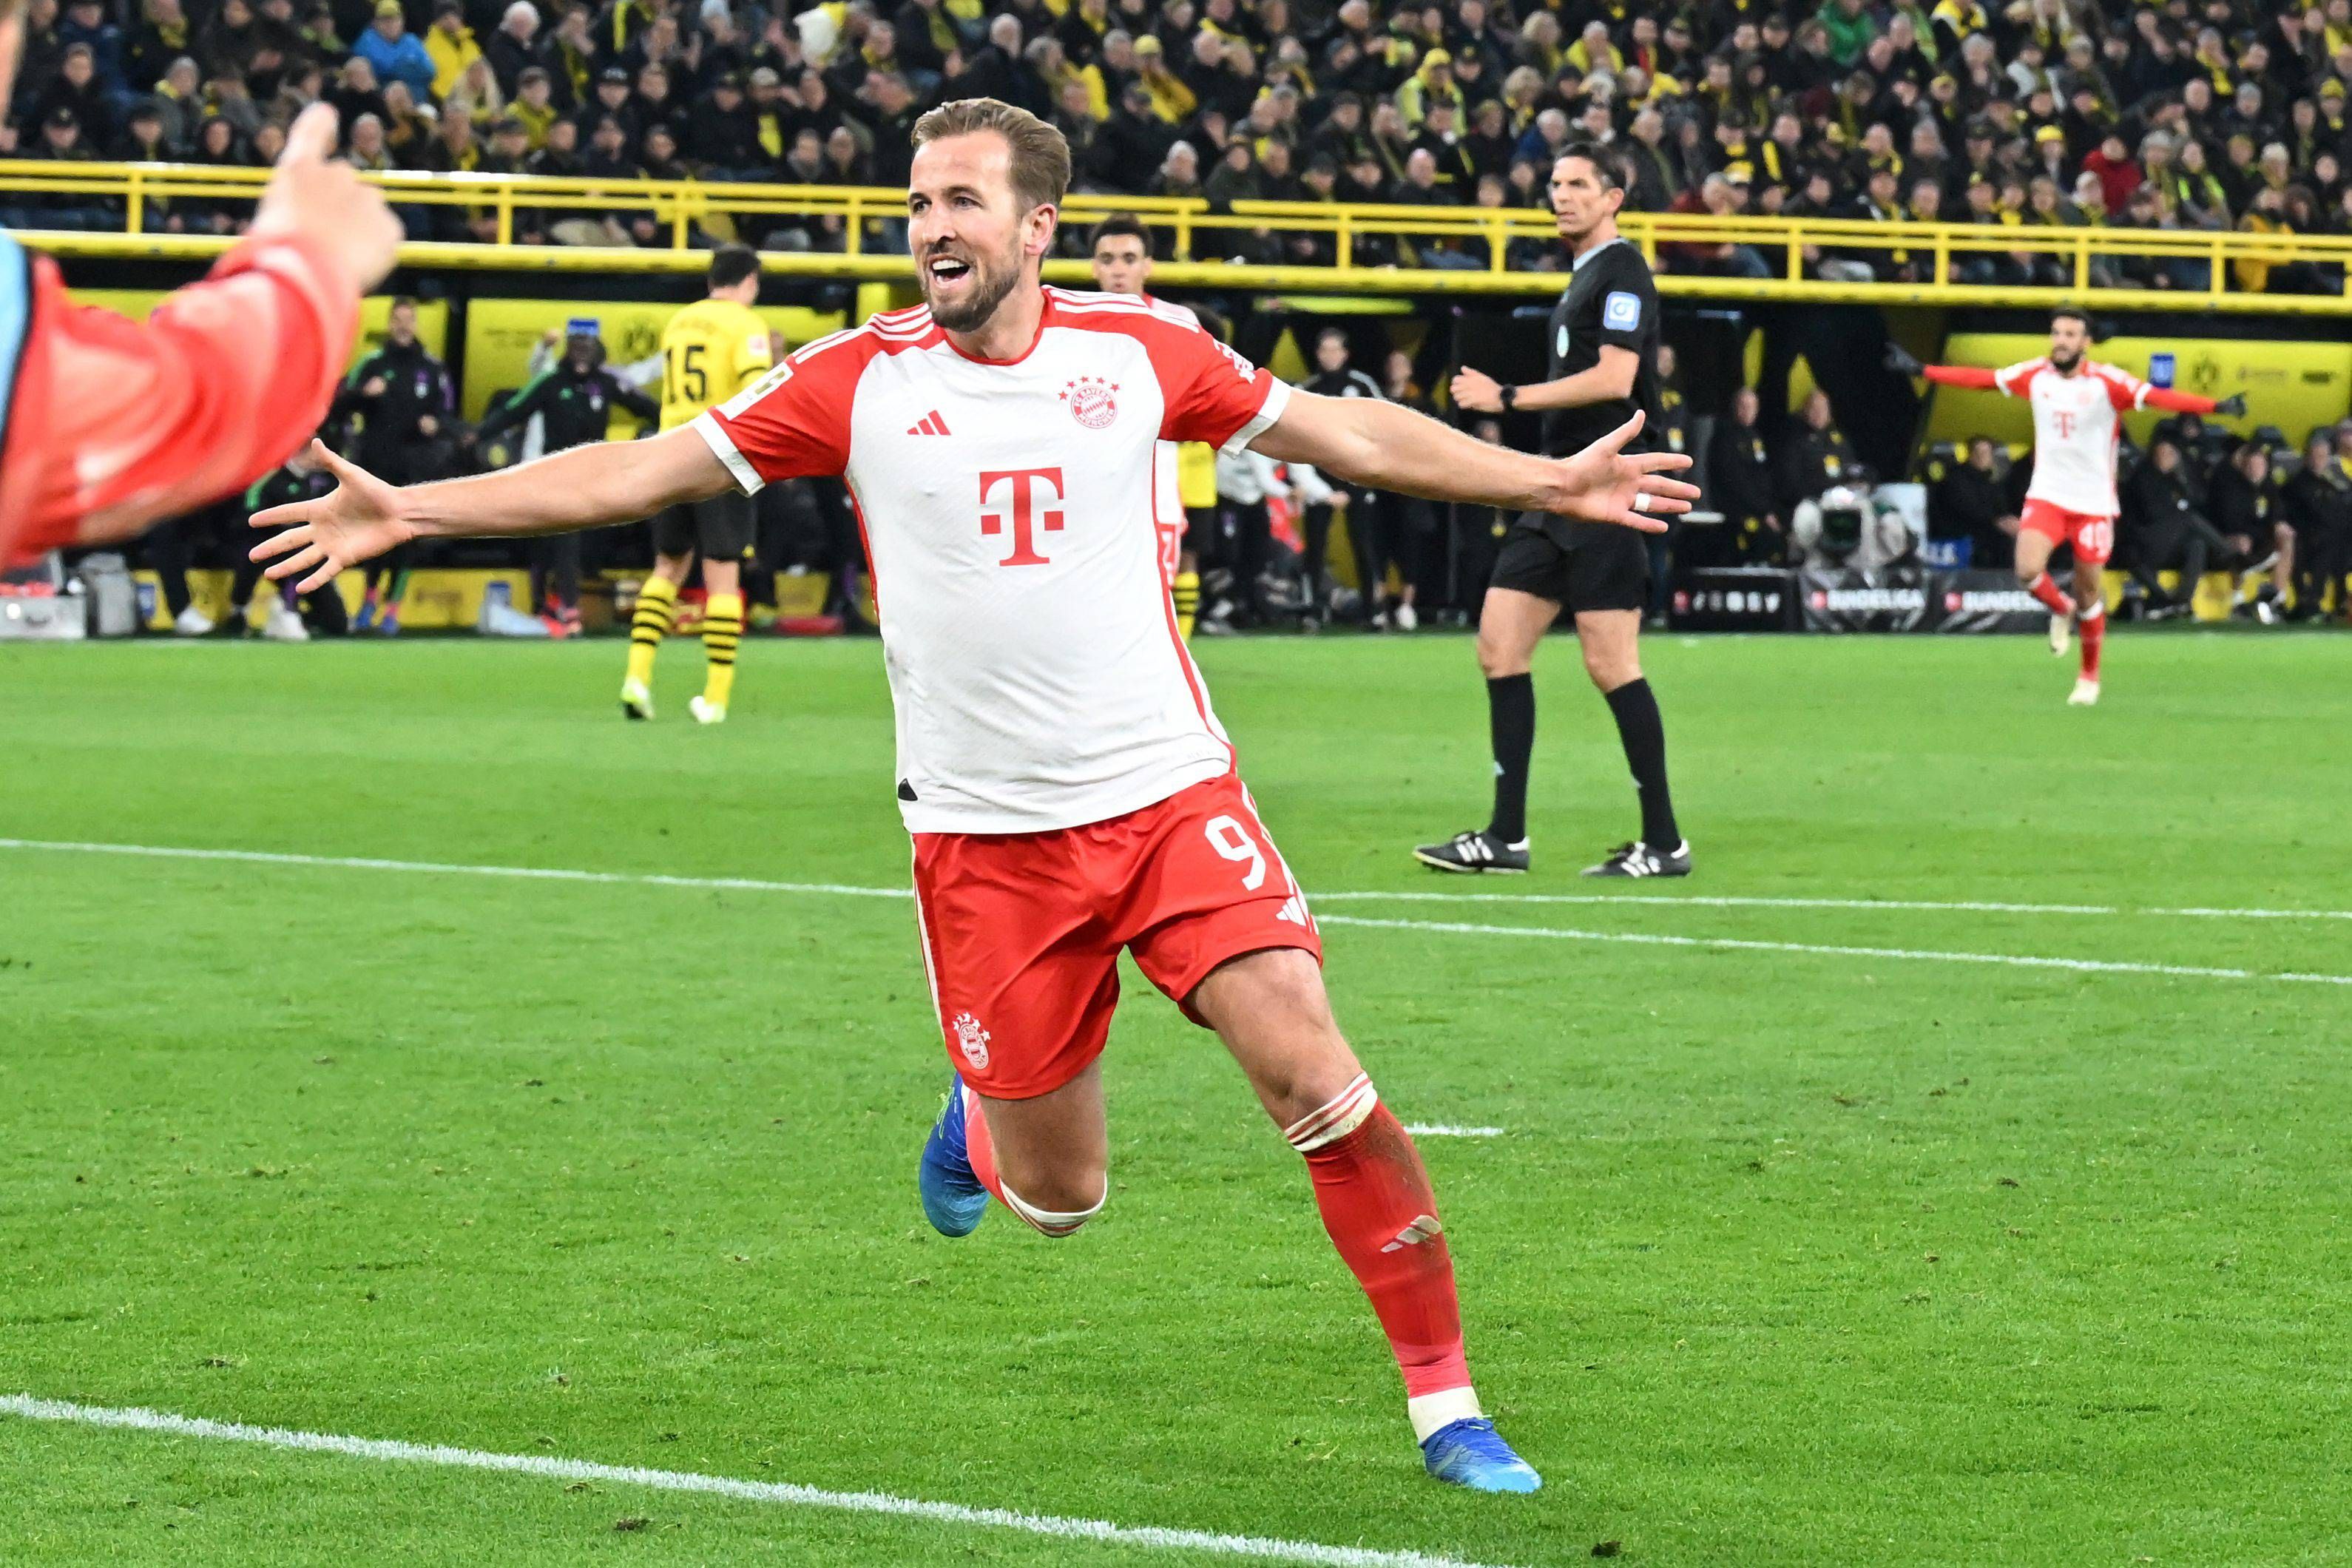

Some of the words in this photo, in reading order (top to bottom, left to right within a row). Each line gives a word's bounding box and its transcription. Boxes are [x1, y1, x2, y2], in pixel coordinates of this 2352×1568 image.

[665, 345, 707, 404] 15
[979, 467, 1064, 567] T
[1204, 814, 1266, 891] 9
